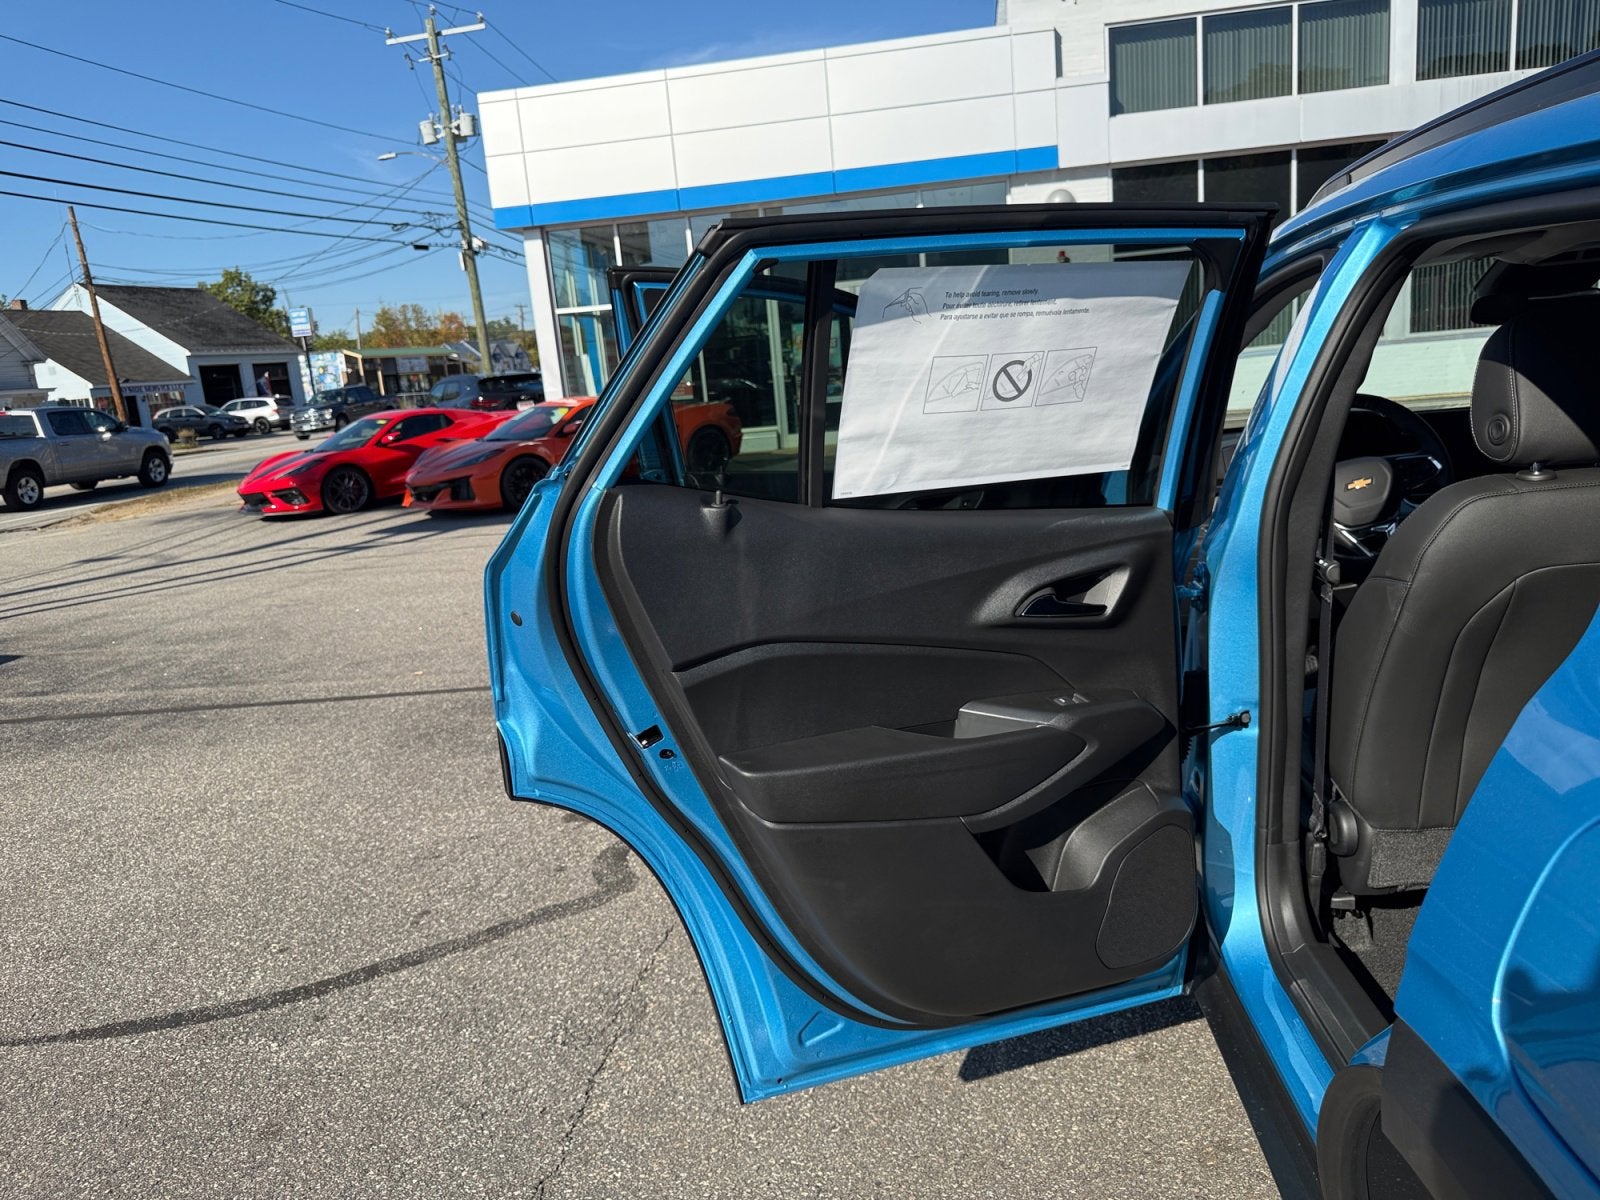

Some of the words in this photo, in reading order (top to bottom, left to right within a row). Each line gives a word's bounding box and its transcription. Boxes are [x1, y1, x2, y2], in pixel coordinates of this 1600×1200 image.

[953, 291, 965, 299] help
[965, 290, 980, 298] avoid
[940, 313, 952, 321] Para
[999, 312, 1010, 320] que
